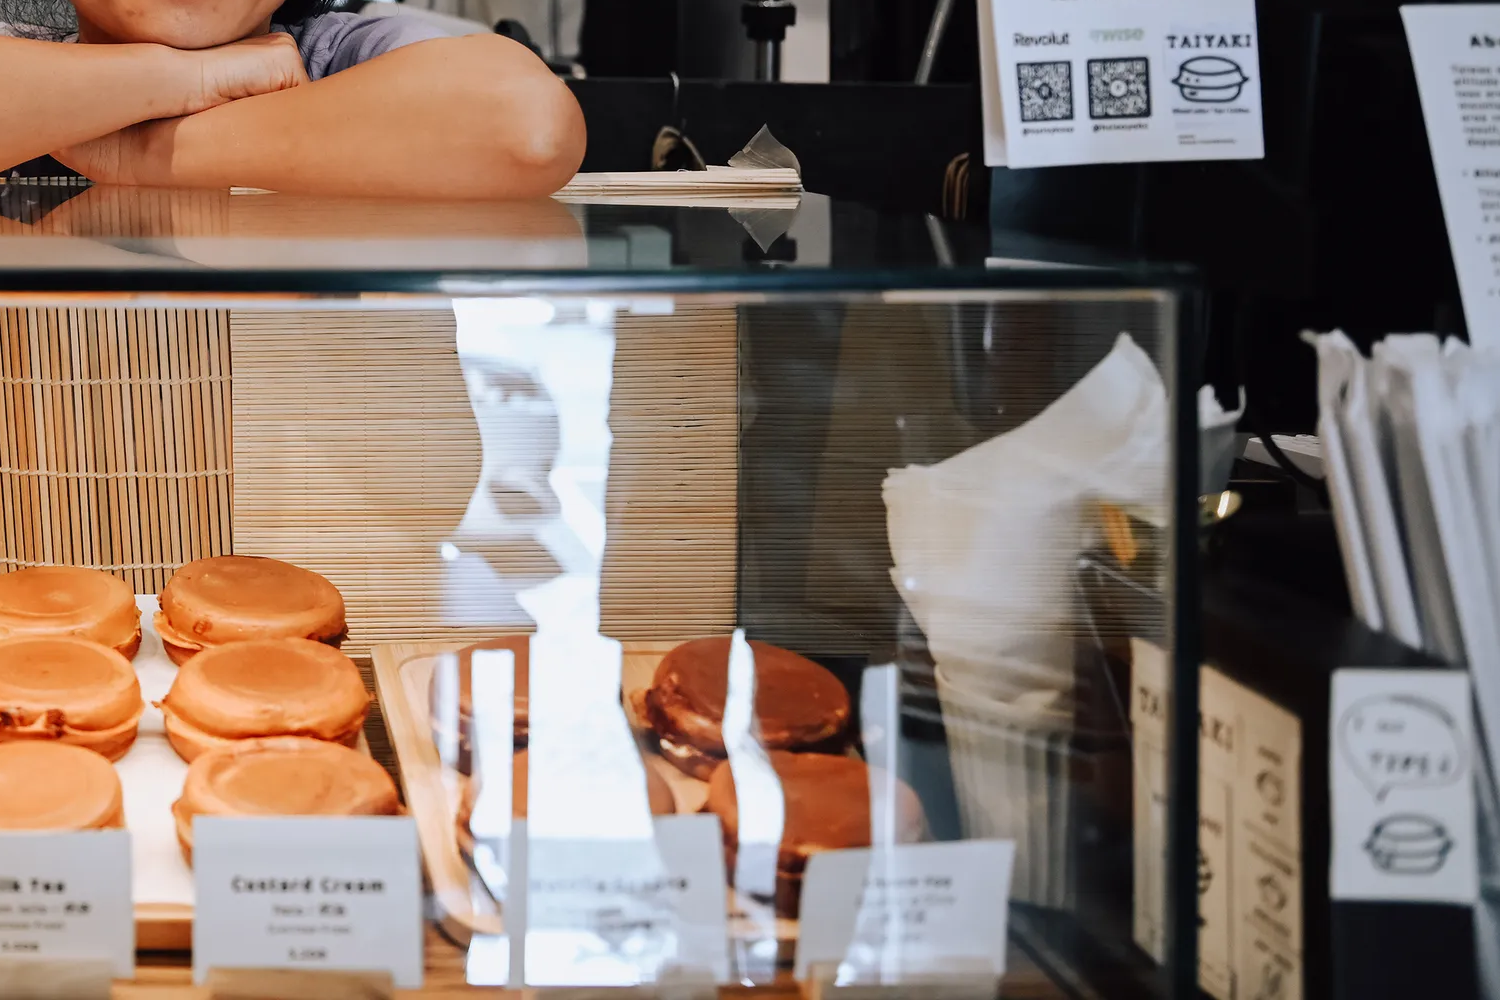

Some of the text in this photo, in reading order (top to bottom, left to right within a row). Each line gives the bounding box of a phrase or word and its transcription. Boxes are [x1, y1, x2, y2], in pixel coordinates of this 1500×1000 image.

[1014, 33, 1070, 47] Revolut
[1167, 34, 1252, 49] TAIYAKI
[231, 875, 385, 893] Custard Cream
